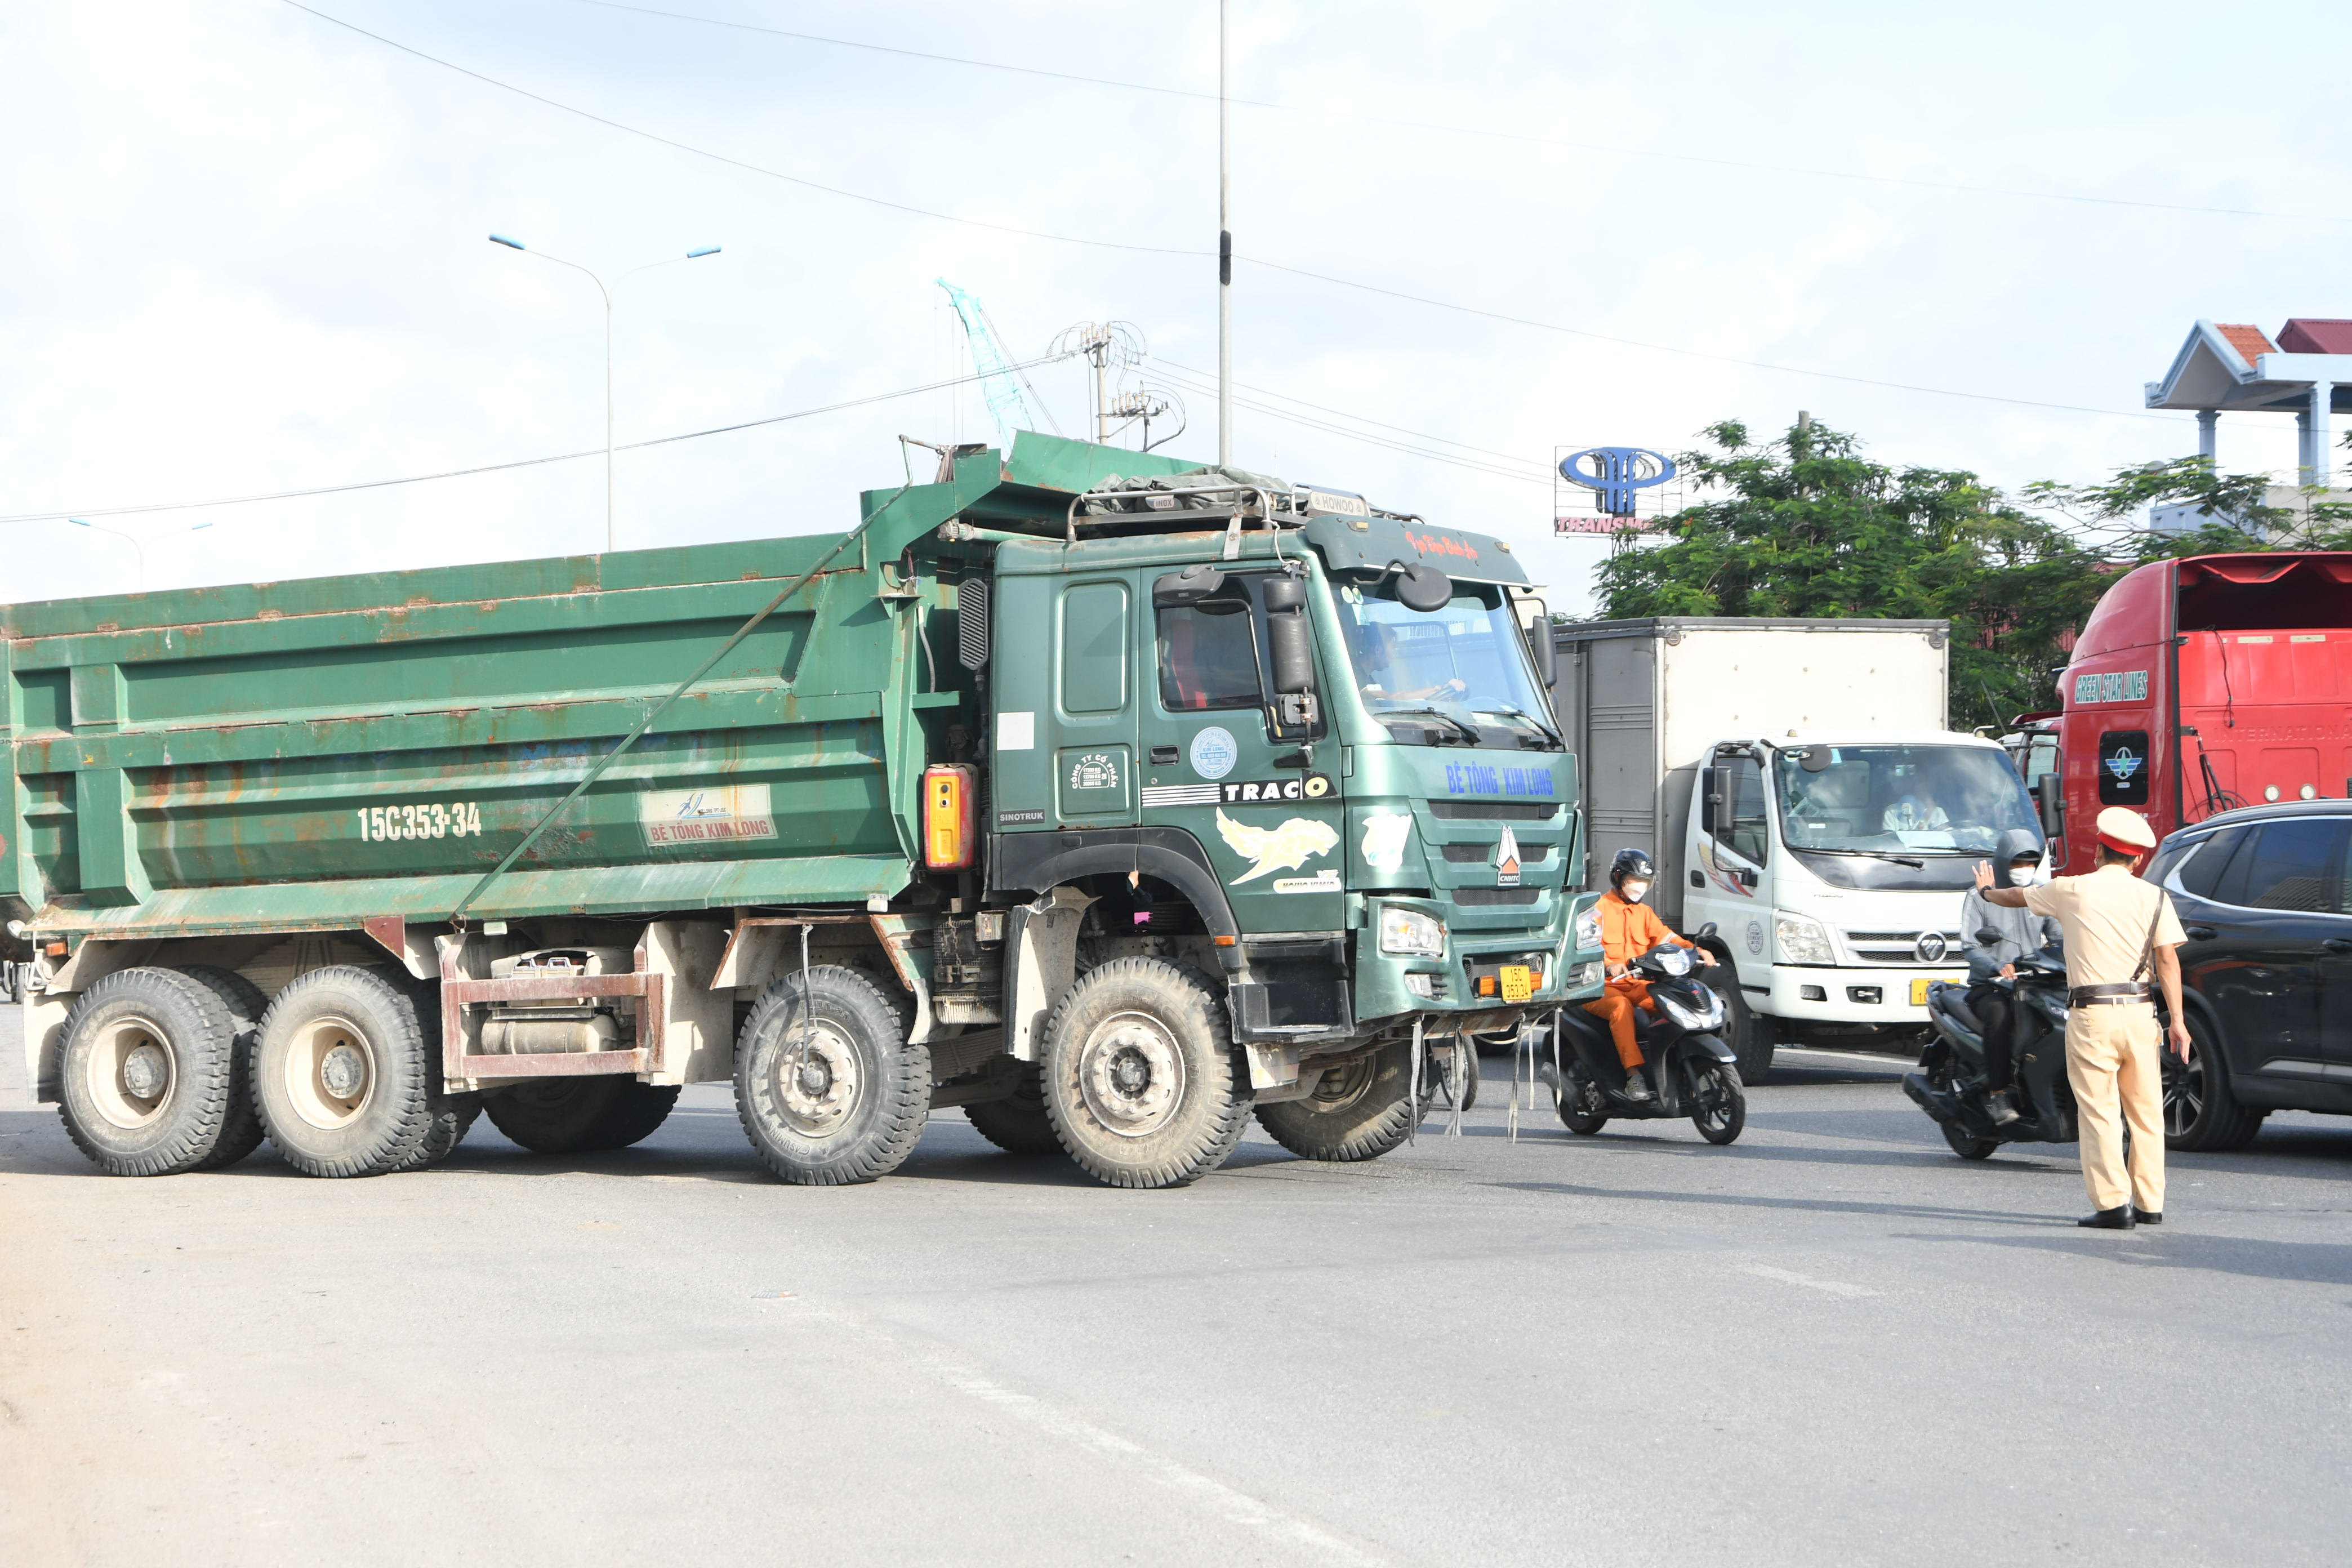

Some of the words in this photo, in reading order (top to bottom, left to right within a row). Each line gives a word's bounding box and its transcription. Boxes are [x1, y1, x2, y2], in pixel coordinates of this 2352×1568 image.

[2075, 674, 2102, 704] GREEN
[2102, 672, 2123, 703] STAR
[2123, 670, 2148, 701] LINES
[1081, 754, 1092, 763] TY
[1225, 777, 1328, 801] TRACO
[1446, 760, 1464, 794] BÊ
[1464, 761, 1499, 794] TÔNG
[1503, 767, 1526, 795] KIM
[1525, 768, 1554, 796] LONG
[358, 802, 482, 841] 15C353-34
[1000, 812, 1044, 821] SINOTRUK
[651, 823, 668, 841] BÊ
[706, 822, 732, 838] KIM
[733, 820, 769, 836] LONG
[1511, 968, 1522, 982] 15C
